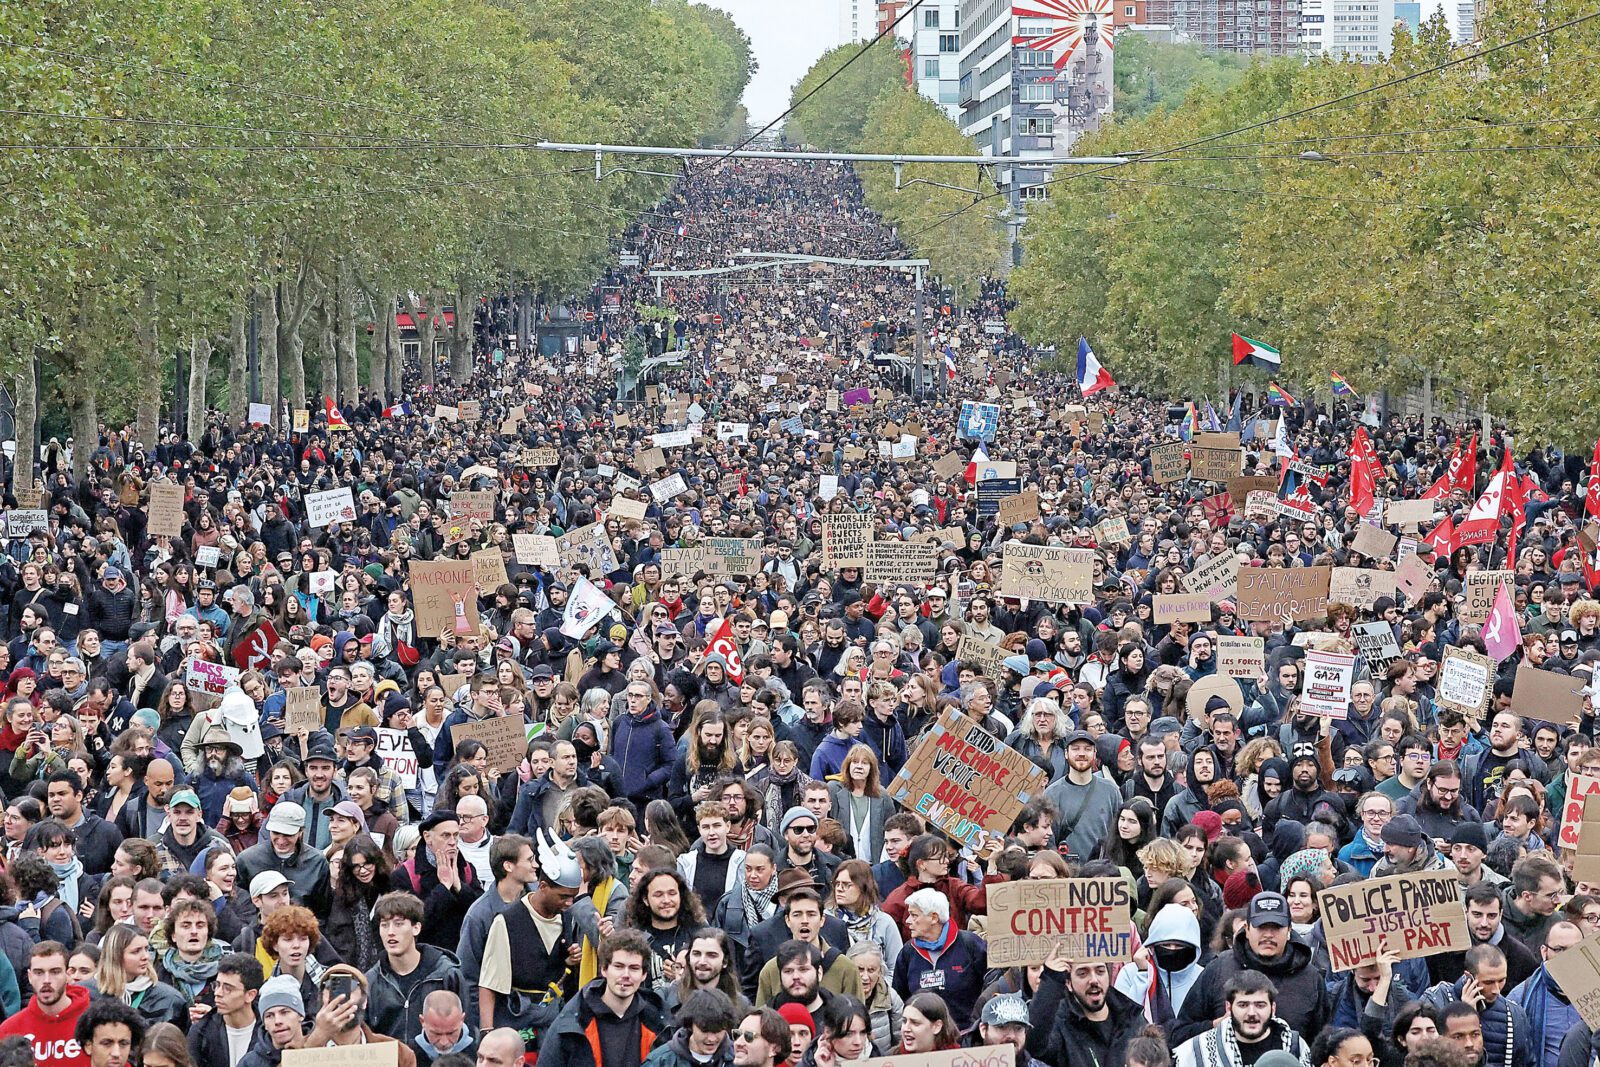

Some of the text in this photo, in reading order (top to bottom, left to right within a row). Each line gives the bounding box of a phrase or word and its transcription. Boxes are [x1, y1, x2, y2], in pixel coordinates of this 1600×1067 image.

[1152, 444, 1183, 455] PROFITS
[526, 457, 557, 465] METHOD
[827, 522, 872, 530] FRAUDEURS
[828, 536, 867, 546] CRAPULES
[714, 547, 745, 557] ESSENCE
[827, 544, 864, 552] HAINEUX
[693, 549, 704, 561] QU
[828, 552, 864, 560] ORDURES
[685, 562, 700, 574] LES
[1220, 567, 1231, 577] LA
[412, 569, 472, 586] MACRONIE
[1187, 576, 1198, 587] LA
[1280, 572, 1306, 588] MAL
[1475, 588, 1486, 597] ET
[427, 594, 441, 609] BE
[1239, 596, 1328, 617] DÉMOCRATIE
[1159, 604, 1174, 615] NIK
[424, 615, 453, 632] LIKE
[1353, 626, 1369, 636] LA
[990, 647, 1006, 661] VID
[1362, 646, 1384, 659] C'EST
[188, 678, 200, 688] SE
[1314, 671, 1341, 683] GAZA
[944, 715, 970, 739] UNE
[992, 749, 1031, 775] DANS
[384, 757, 417, 775] TION
[933, 778, 998, 827] BOUCHE
[915, 793, 990, 851] ENFANTS
[989, 880, 1130, 912] C'EST NOUS
[1321, 878, 1460, 929] POLICE PARTOUT
[1010, 906, 1113, 936] CONTRE
[1362, 907, 1433, 935] JUSTICE
[987, 936, 1036, 964] CEUX
[1086, 932, 1130, 958] HAUT
[1331, 921, 1452, 971] NULLE PART
